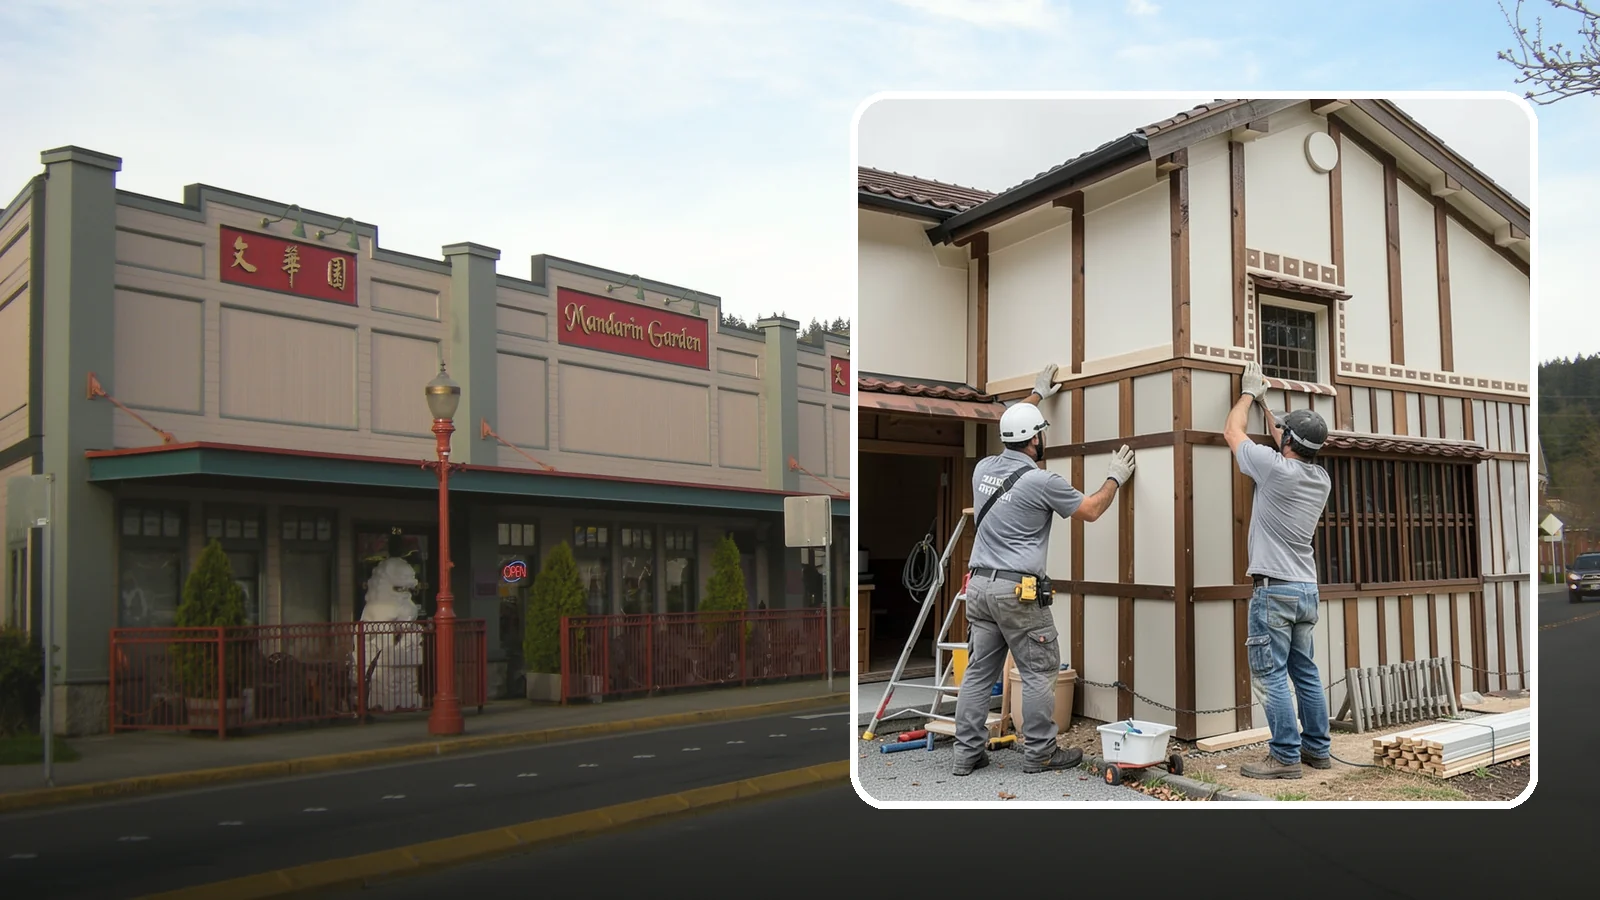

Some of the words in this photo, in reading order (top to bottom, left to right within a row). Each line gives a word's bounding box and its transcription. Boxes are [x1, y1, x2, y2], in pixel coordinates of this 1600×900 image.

[231, 235, 346, 290] 文華園
[564, 302, 644, 341] Mandarin
[648, 320, 701, 352] Garden
[834, 363, 846, 386] 文
[503, 565, 527, 578] OPEN
